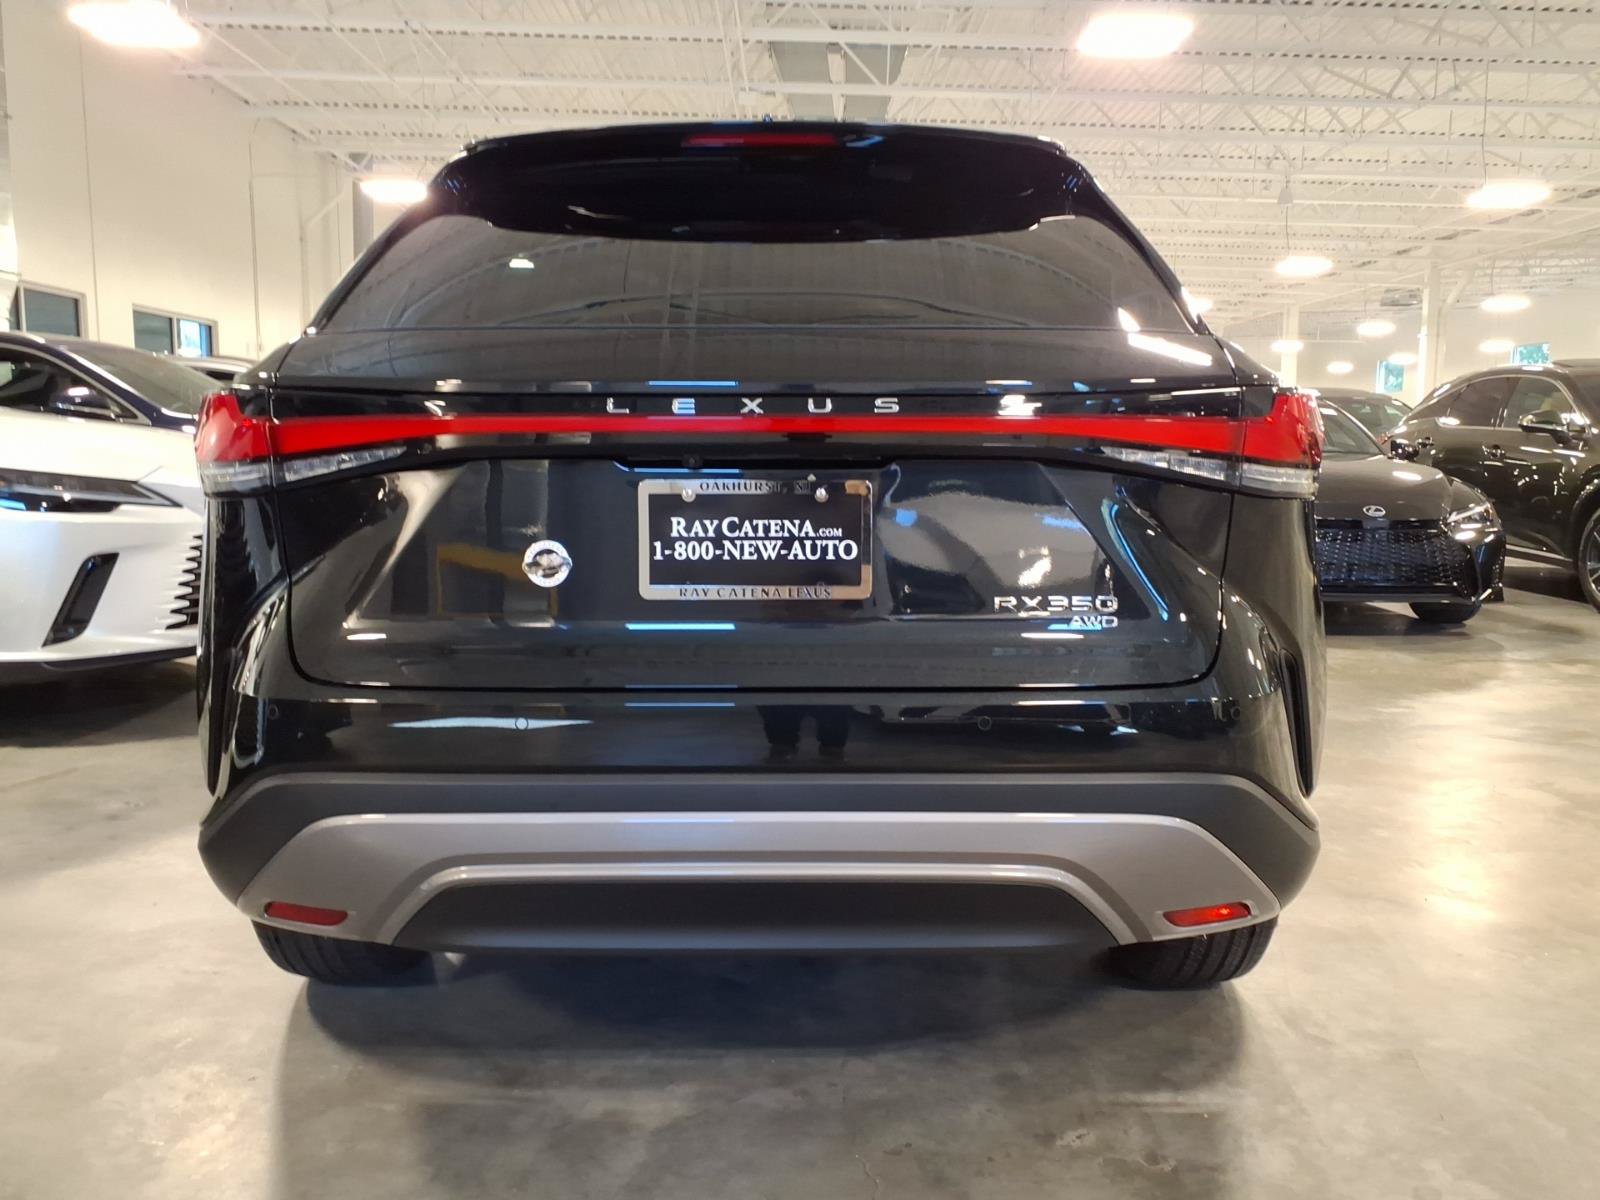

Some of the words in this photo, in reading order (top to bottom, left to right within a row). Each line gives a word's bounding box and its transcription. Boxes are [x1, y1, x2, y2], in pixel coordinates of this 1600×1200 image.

[606, 397, 900, 414] LEXUS
[653, 539, 859, 560] 1-800-NEW-AUTO
[679, 587, 710, 598] RAY
[717, 587, 782, 598] CATENA
[787, 587, 832, 598] LEXUS
[994, 595, 1118, 613] RX350
[1069, 615, 1118, 629] AWD
